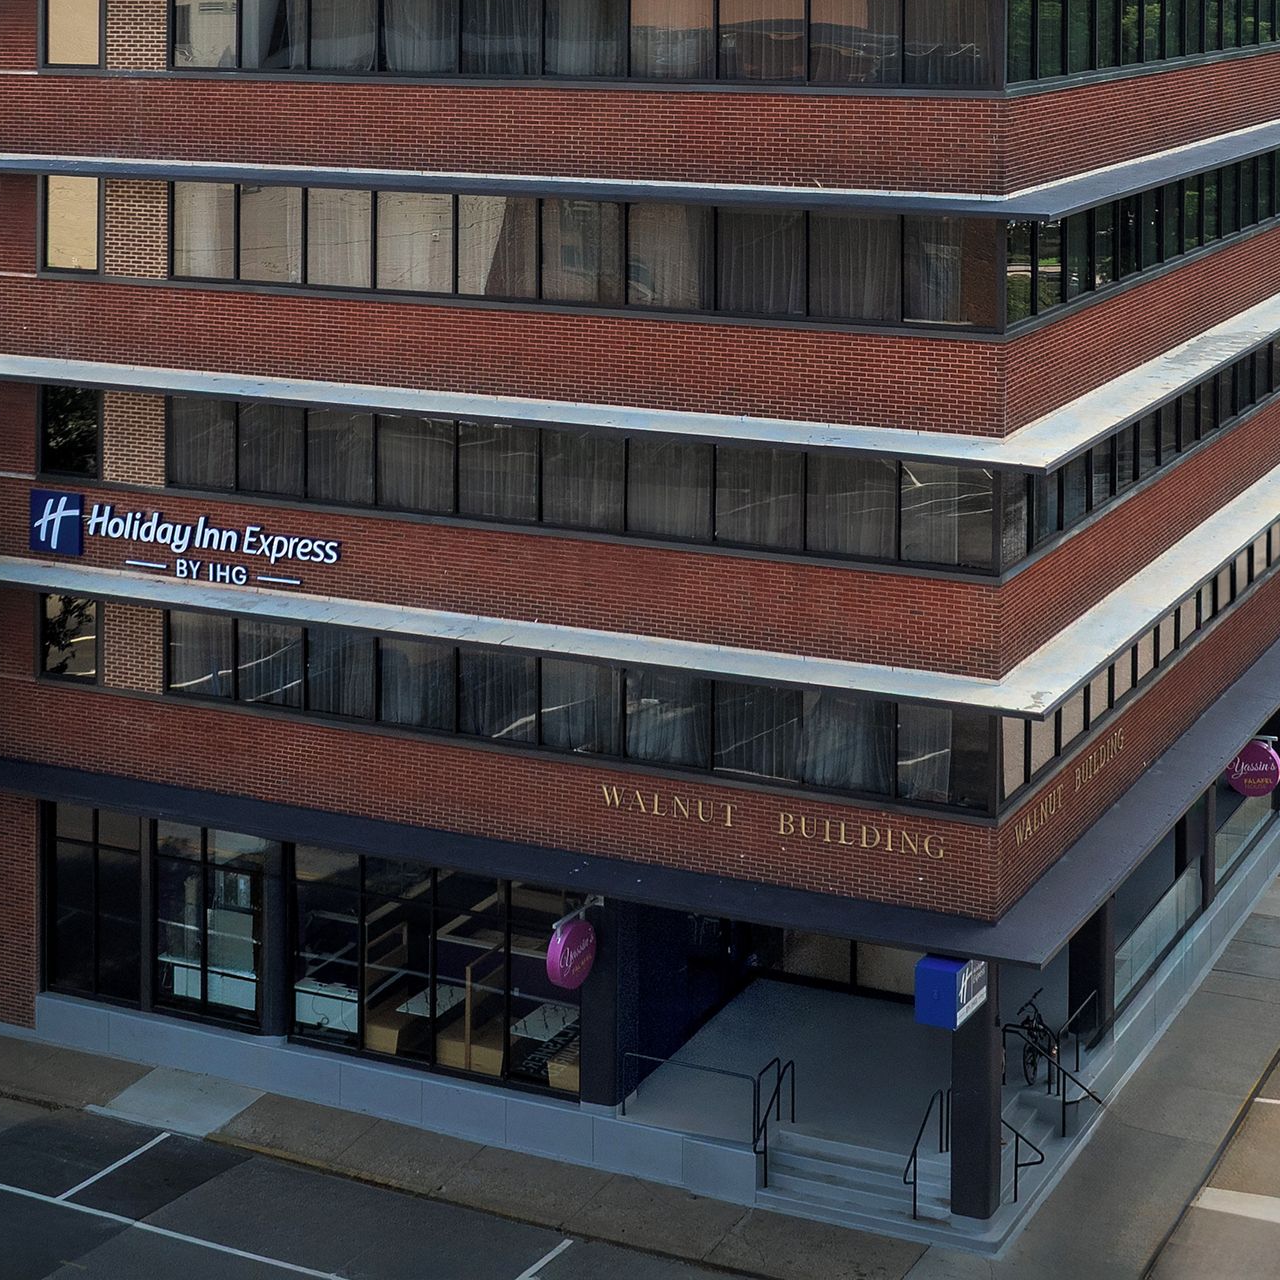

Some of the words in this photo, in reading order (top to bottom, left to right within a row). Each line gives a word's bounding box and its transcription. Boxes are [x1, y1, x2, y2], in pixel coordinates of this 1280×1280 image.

[86, 504, 192, 554] Holiday
[193, 515, 238, 553] Inn
[242, 525, 339, 565] Express
[174, 558, 200, 581] BY
[208, 563, 248, 586] IHG
[1013, 783, 1064, 848] WALNUT
[1073, 728, 1126, 793] BUILDING
[1227, 756, 1277, 780] Yassin's
[600, 783, 738, 828] WALNUT
[778, 812, 946, 860] BUILDING
